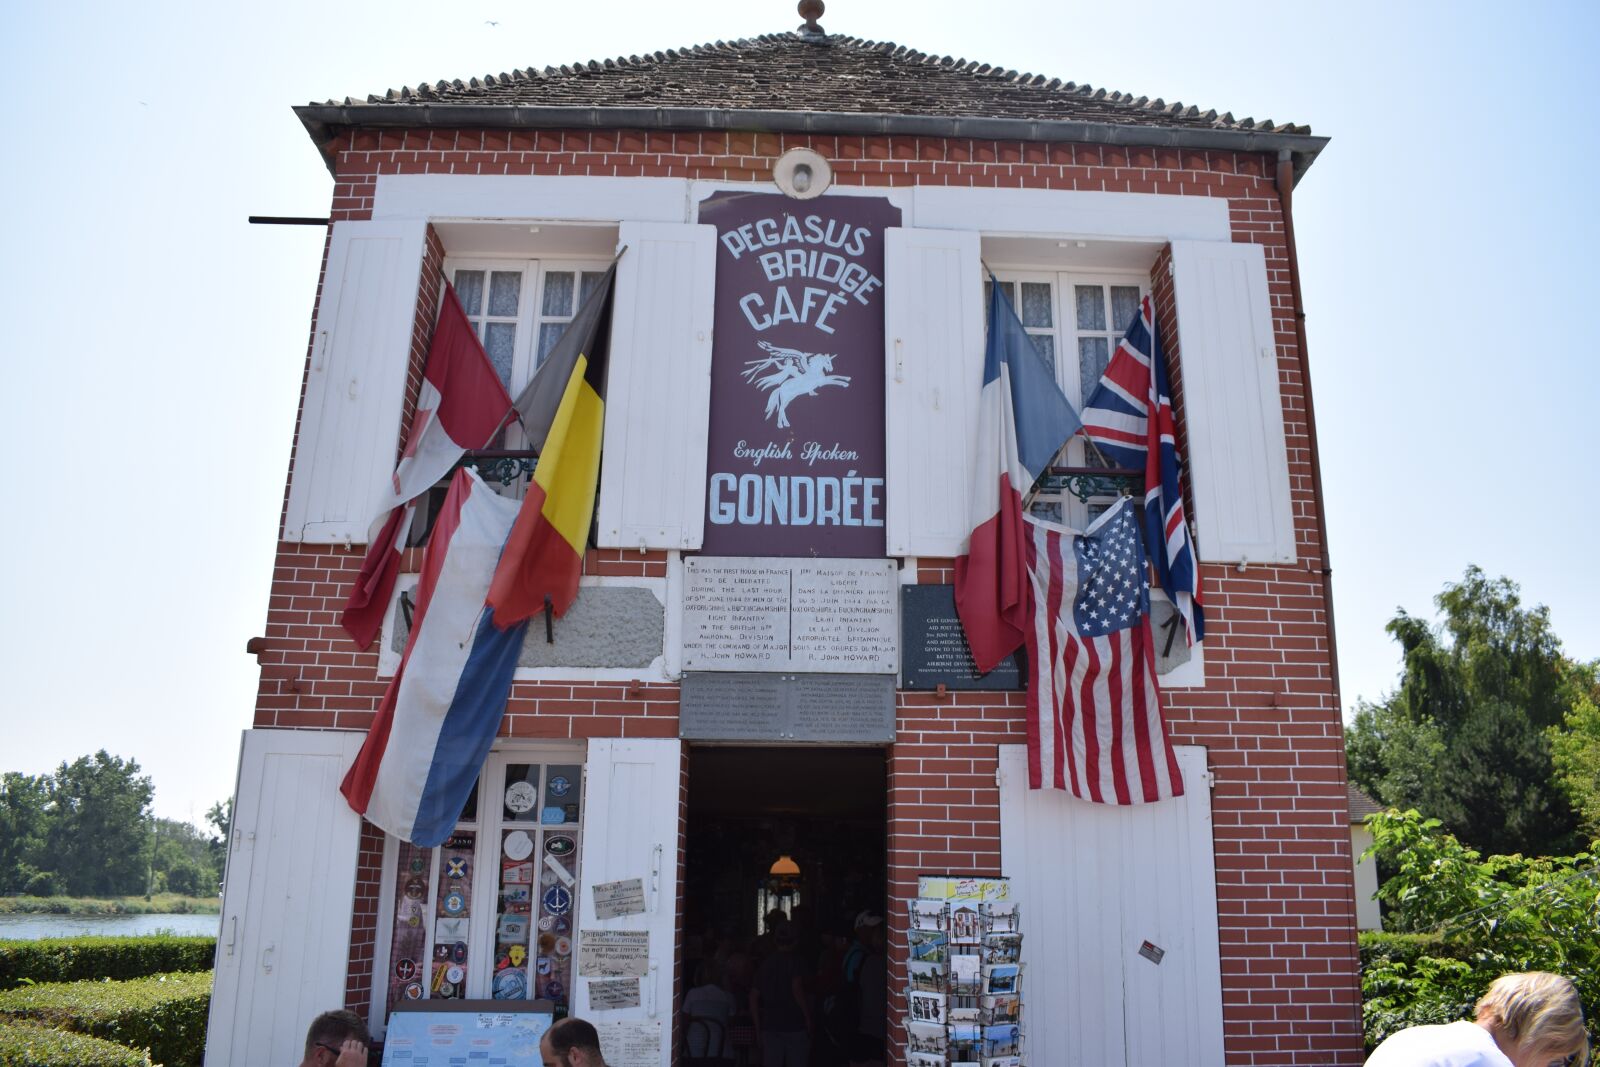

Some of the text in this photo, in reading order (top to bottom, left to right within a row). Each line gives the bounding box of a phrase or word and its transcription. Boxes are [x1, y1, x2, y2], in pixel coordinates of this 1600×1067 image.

[721, 215, 871, 259] PEGASUS
[759, 249, 883, 305] BRIDGE
[739, 286, 848, 334] CAFÉ
[734, 440, 858, 466] English Spoken
[709, 470, 884, 527] GONDRÉE
